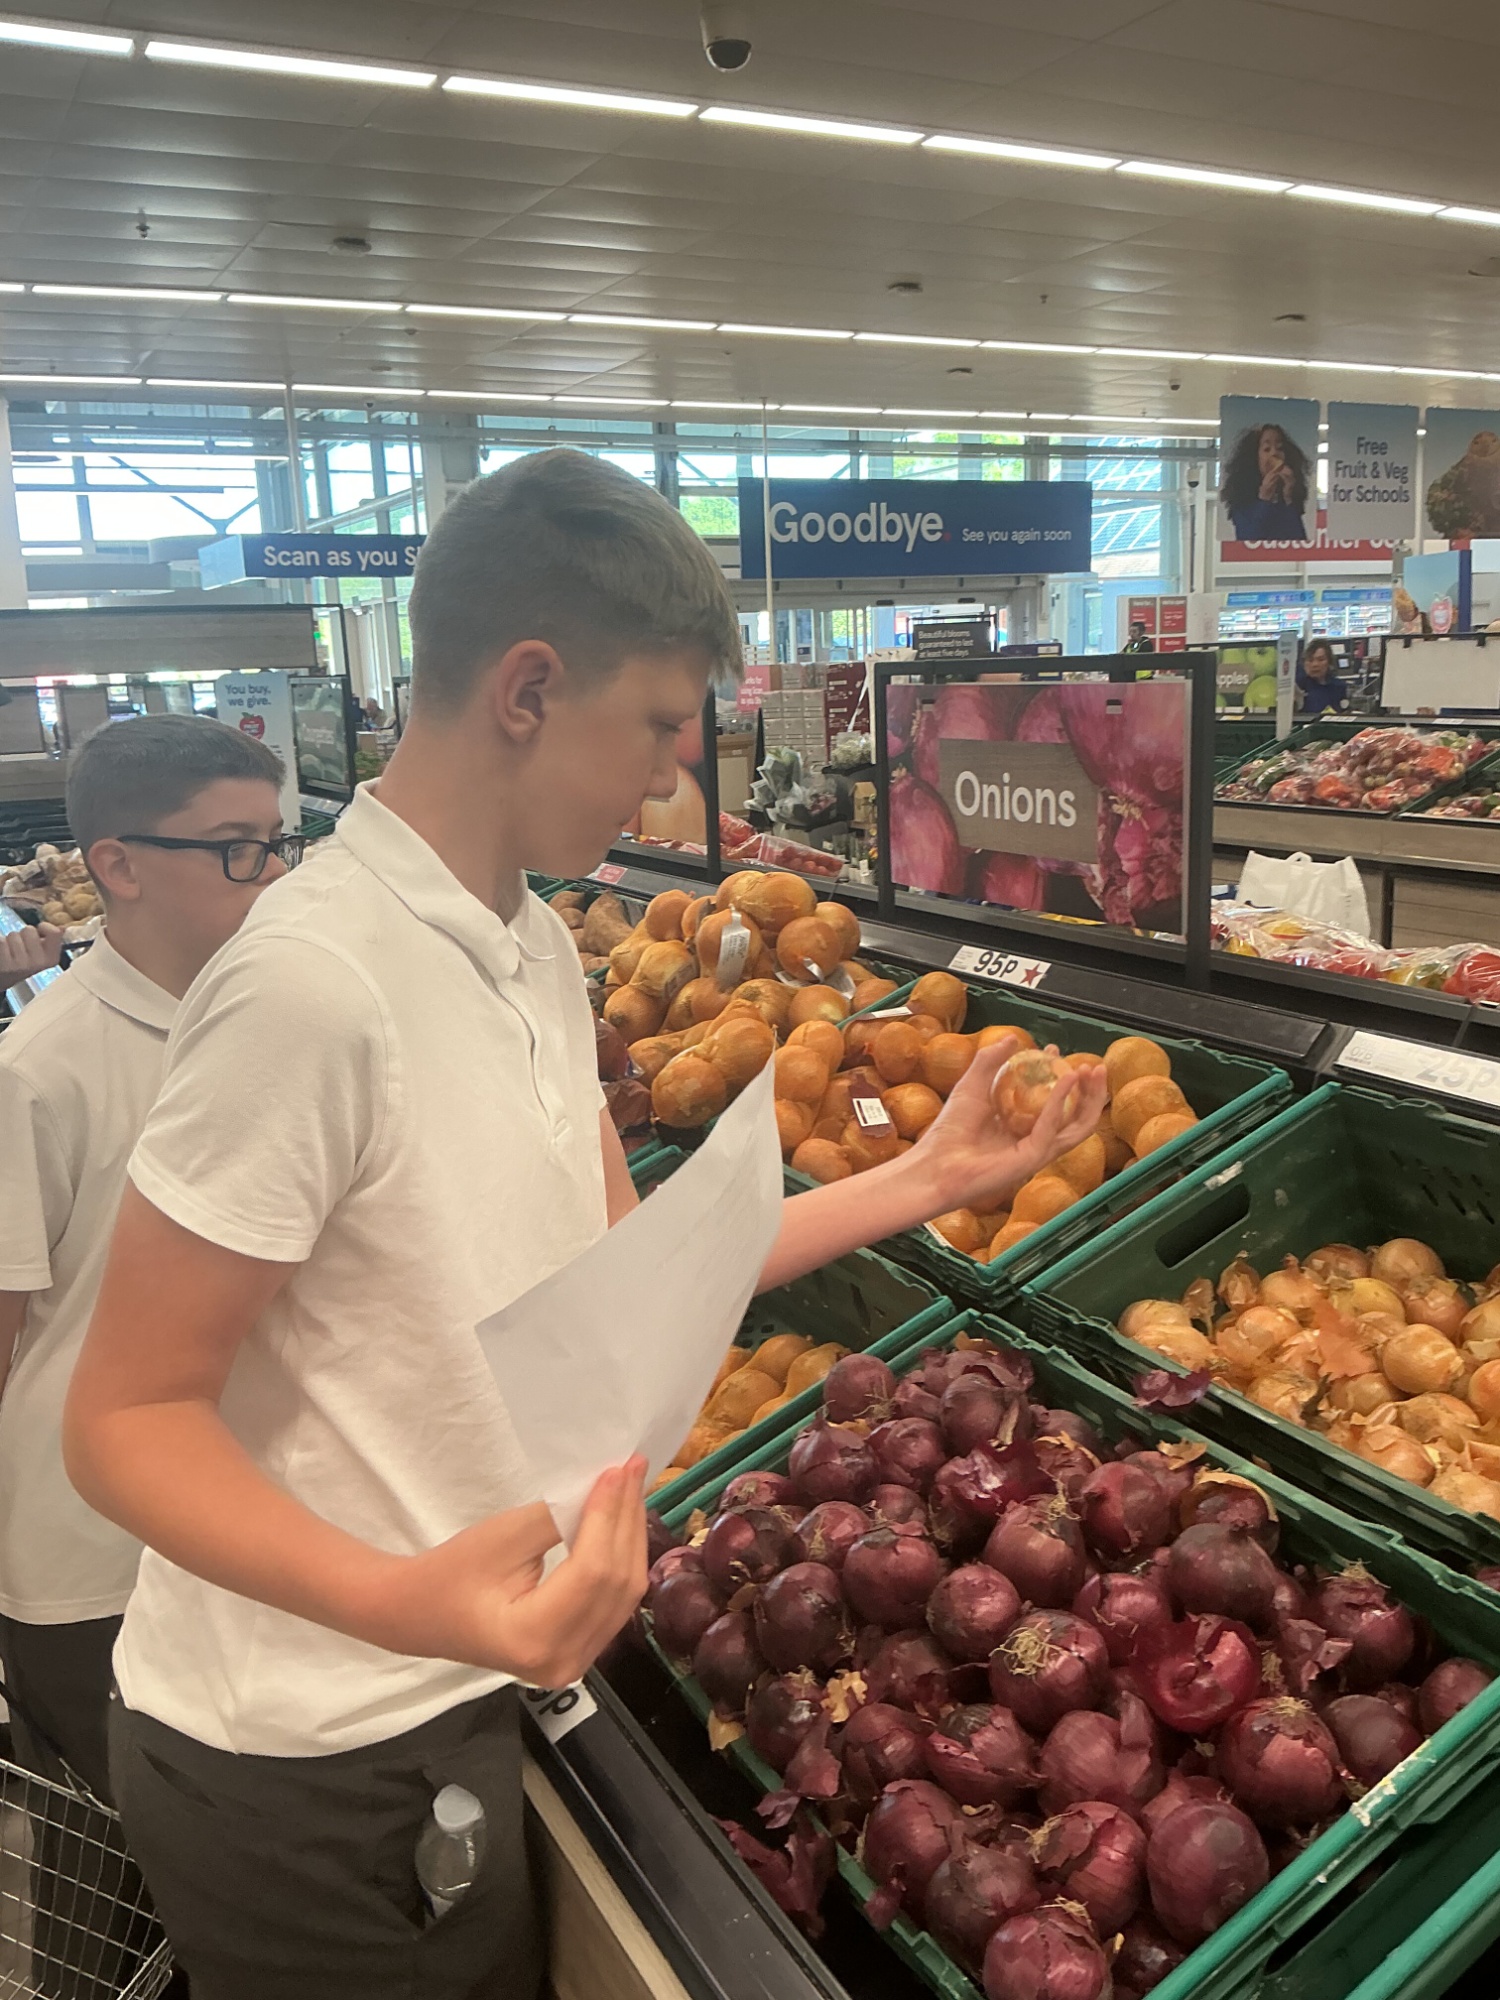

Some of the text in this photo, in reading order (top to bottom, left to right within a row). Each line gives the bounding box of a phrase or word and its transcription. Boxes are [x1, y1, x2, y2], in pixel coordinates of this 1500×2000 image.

[1356, 436, 1389, 456] Free
[1335, 460, 1409, 484] Fruit & Veg
[1332, 484, 1410, 503] for Schools
[962, 528, 1072, 545] See you again soon
[264, 546, 321, 566] Scan
[327, 551, 352, 566] as
[357, 550, 398, 571] you
[225, 684, 246, 694] You
[1216, 671, 1249, 689] pples
[955, 771, 1077, 828] Onions
[973, 950, 1019, 978] 95p
